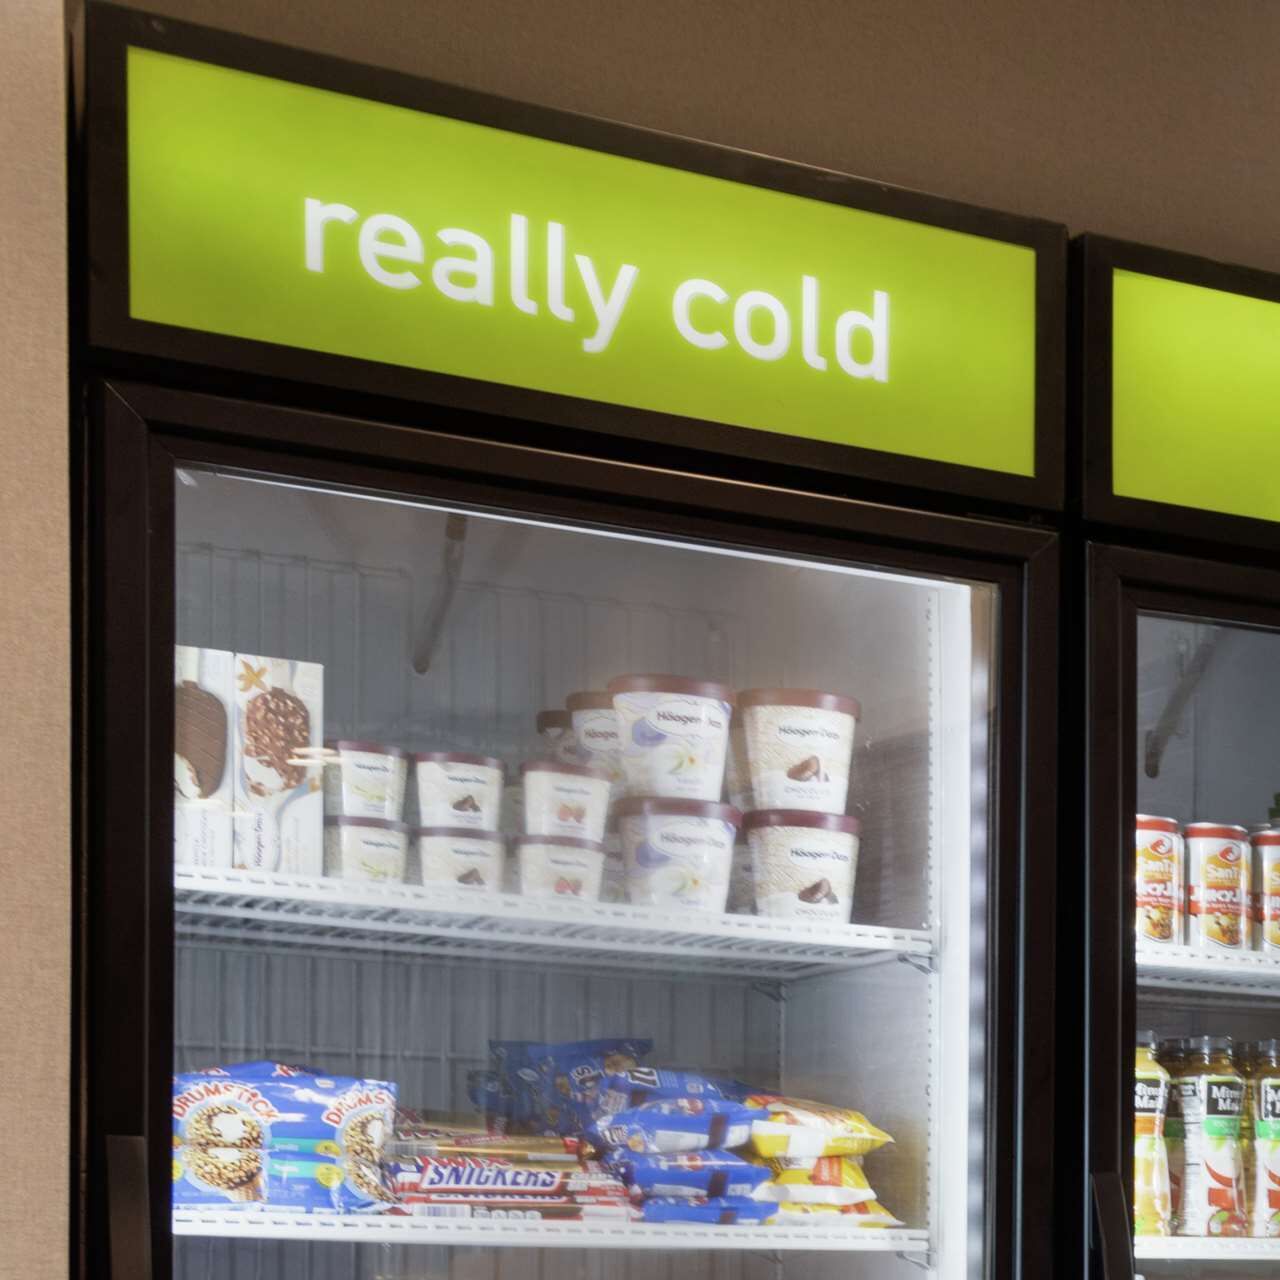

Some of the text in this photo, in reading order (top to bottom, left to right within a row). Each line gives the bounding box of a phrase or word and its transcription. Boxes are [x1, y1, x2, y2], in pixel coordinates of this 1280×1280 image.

[304, 197, 891, 384] really cold
[429, 1164, 559, 1188] SNICKERS
